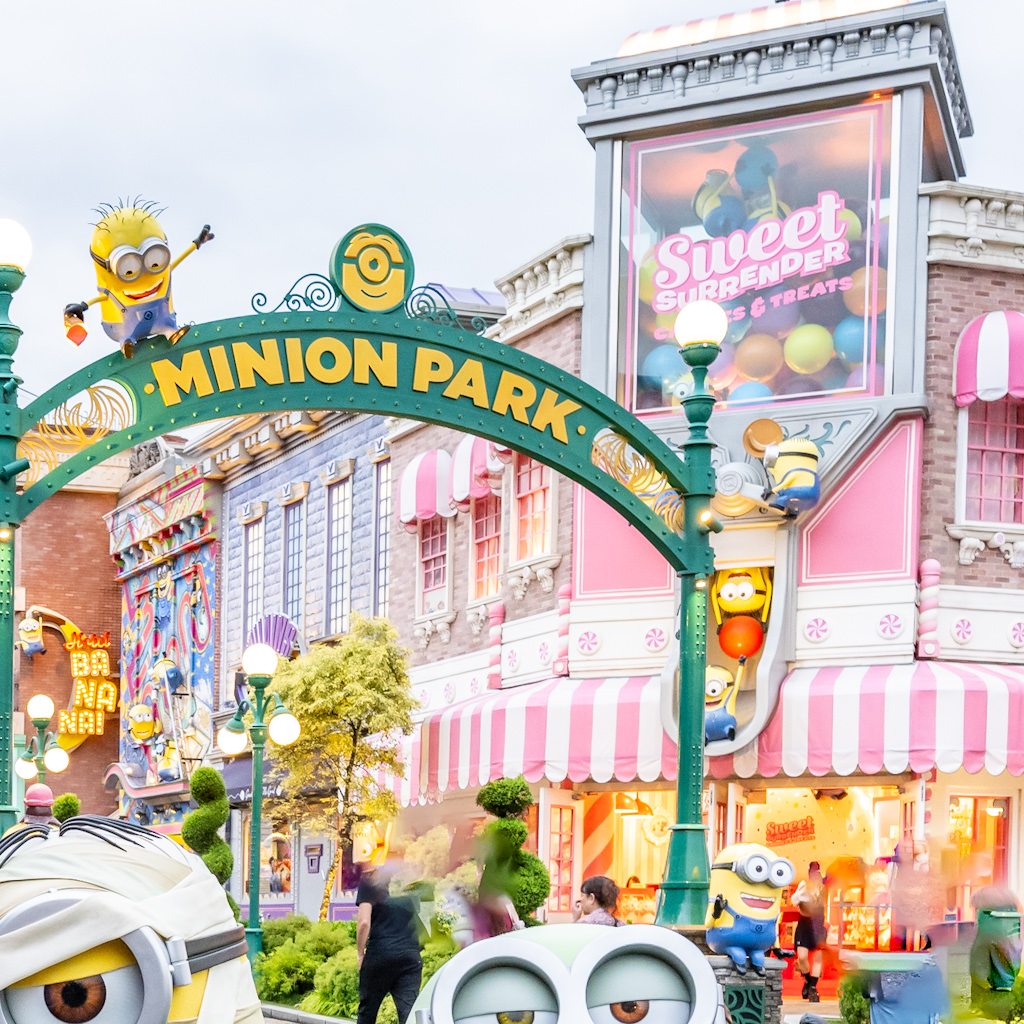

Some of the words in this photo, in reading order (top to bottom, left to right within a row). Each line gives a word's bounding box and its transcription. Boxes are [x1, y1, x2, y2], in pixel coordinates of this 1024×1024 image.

[655, 193, 847, 290] Sweet
[655, 241, 847, 312] SURRENDER
[770, 276, 853, 308] TREATS
[151, 336, 398, 407] MINION
[413, 346, 582, 445] PARK
[70, 649, 110, 677] BA
[75, 677, 117, 712] NA
